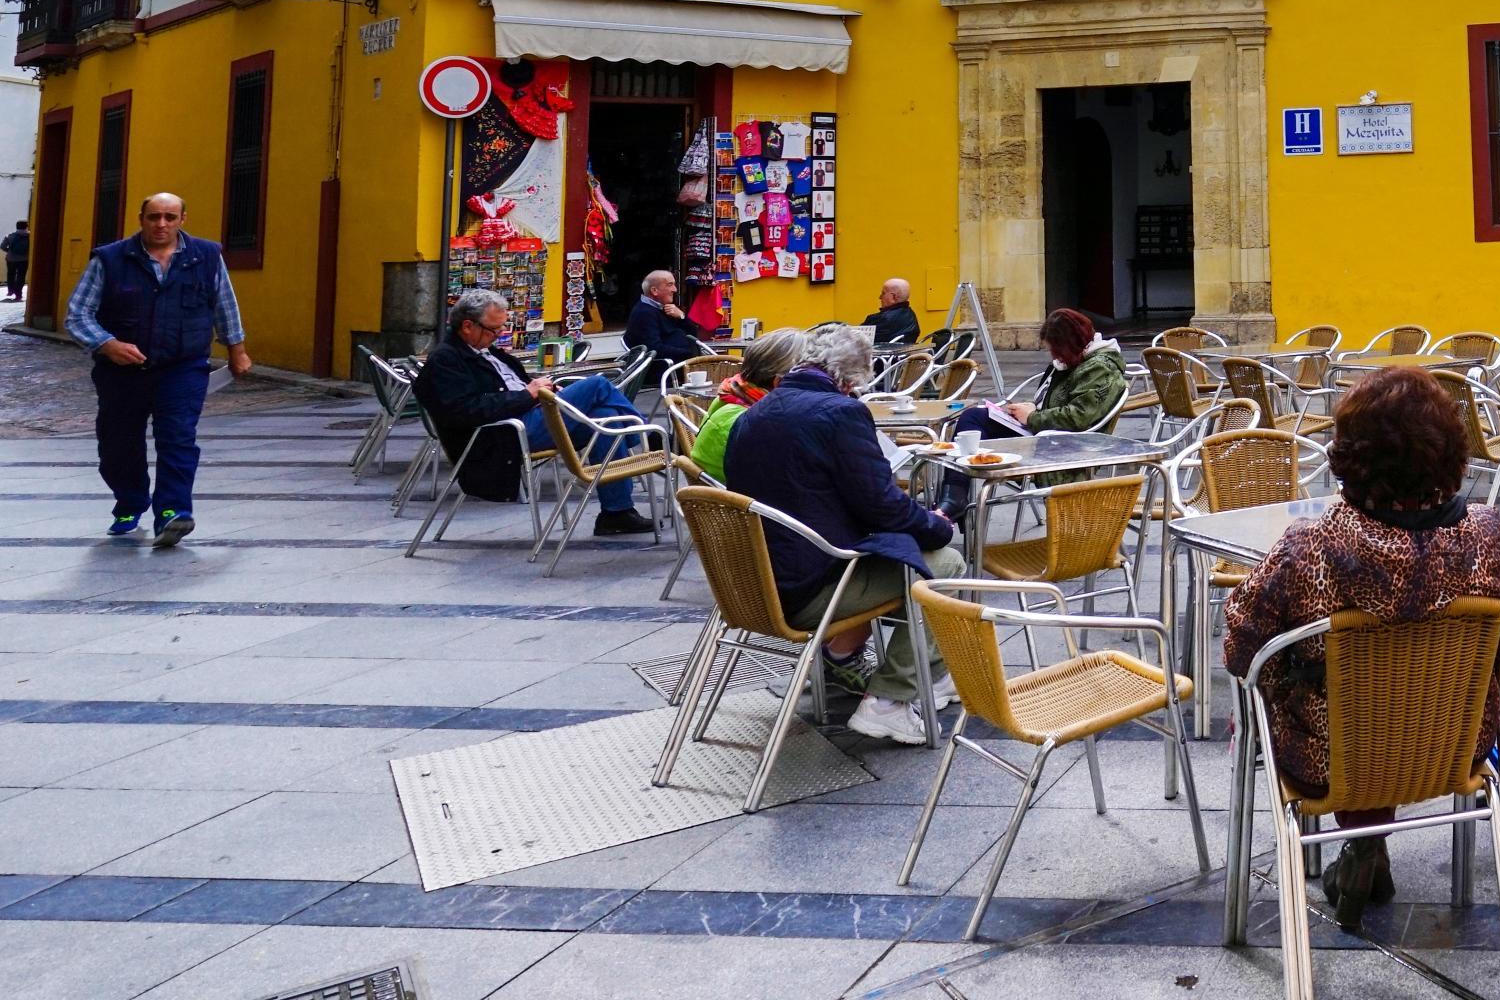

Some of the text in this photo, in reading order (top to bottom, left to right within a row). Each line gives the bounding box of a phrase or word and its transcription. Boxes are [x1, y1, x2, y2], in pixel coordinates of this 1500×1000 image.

[1294, 112, 1312, 134] H
[1362, 116, 1388, 128] Hotel
[1346, 126, 1405, 141] Mezquita
[768, 226, 782, 239] 16
